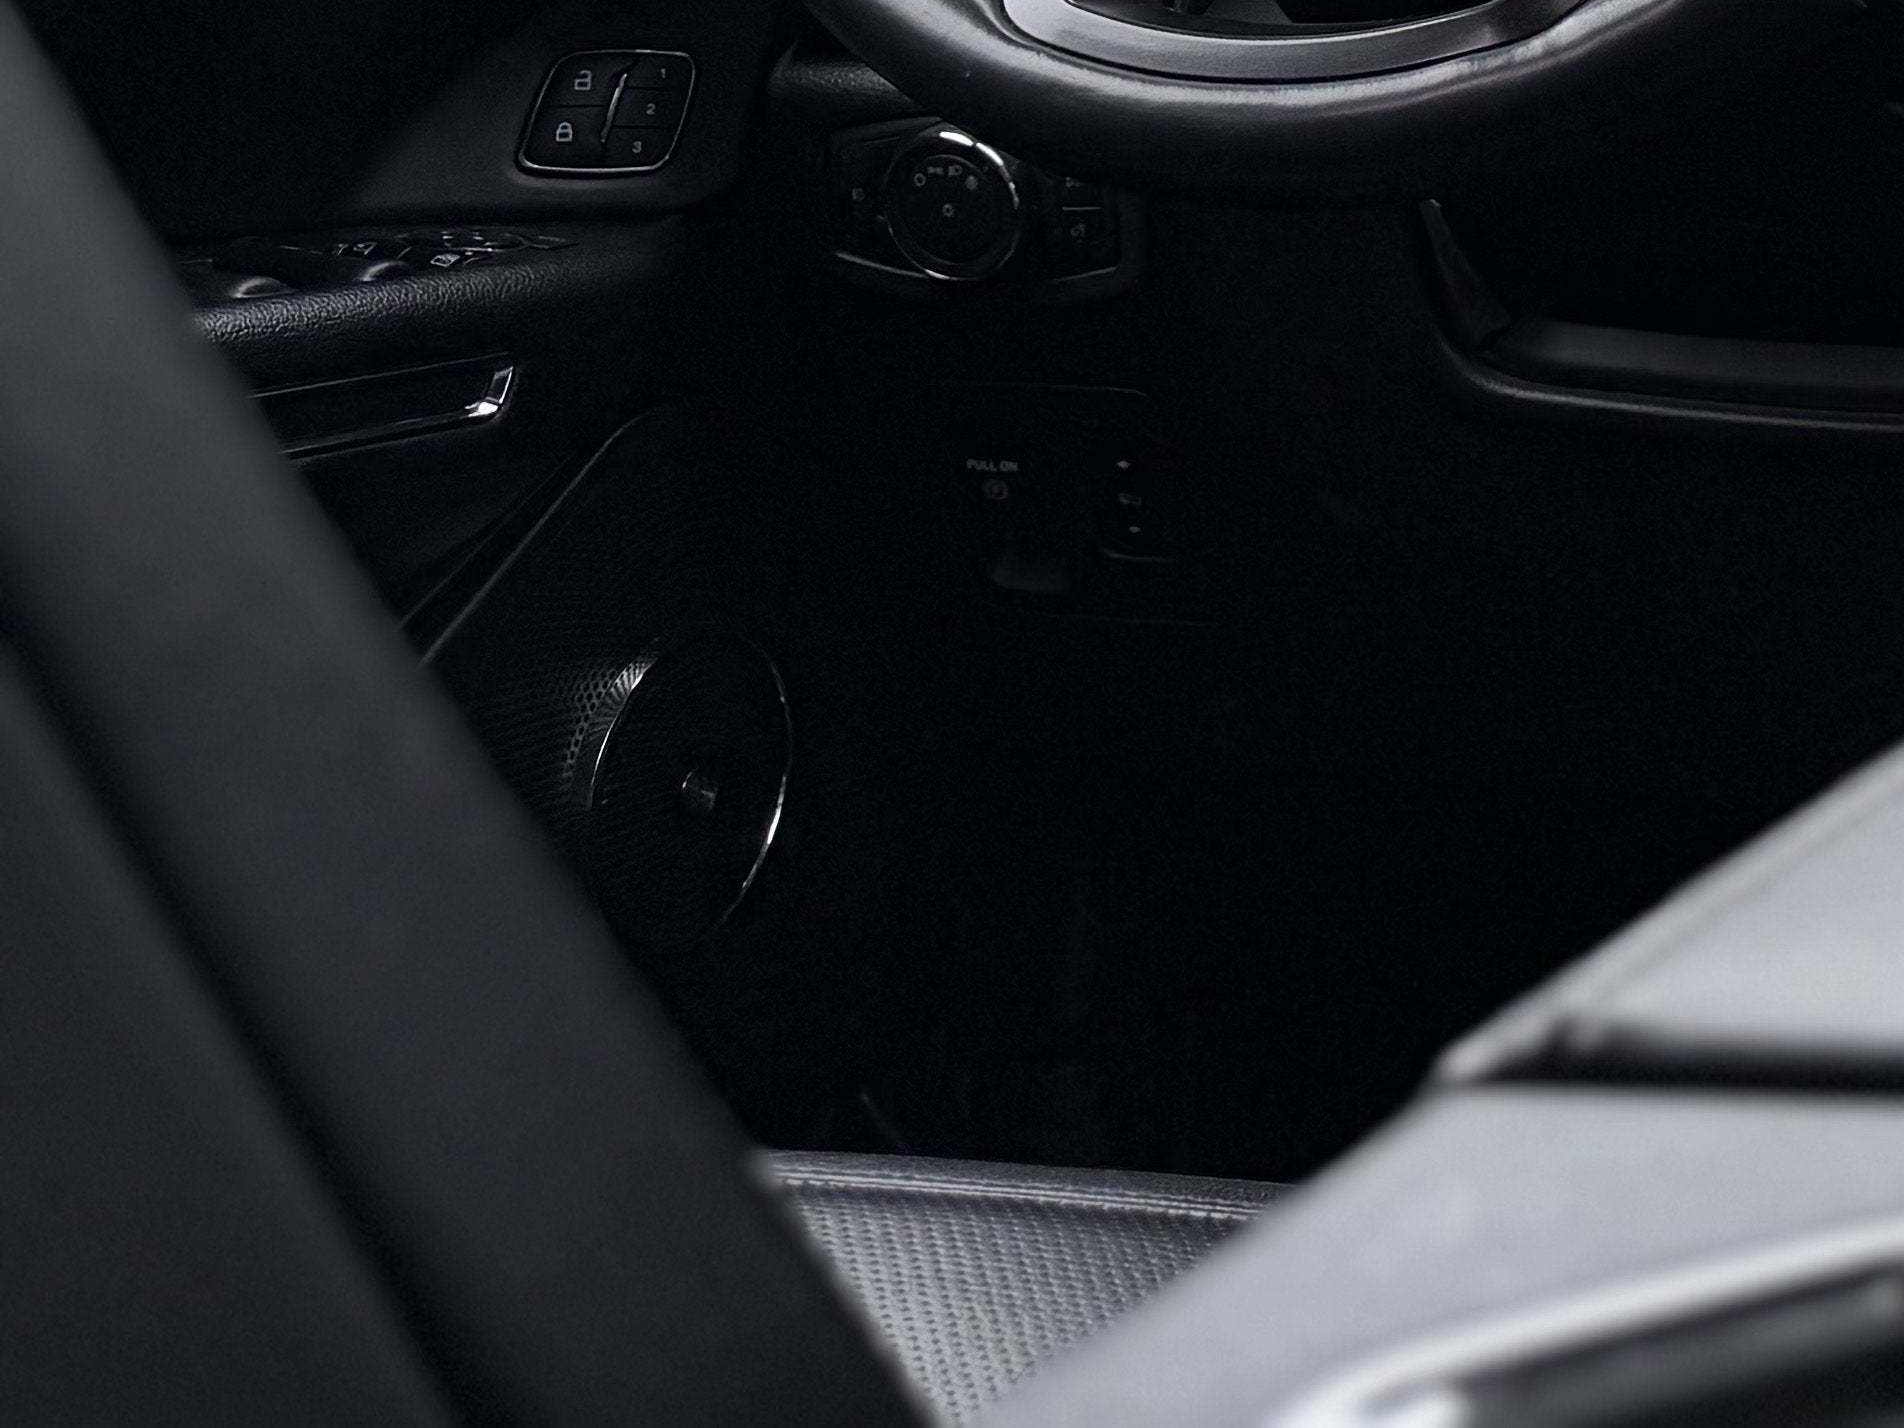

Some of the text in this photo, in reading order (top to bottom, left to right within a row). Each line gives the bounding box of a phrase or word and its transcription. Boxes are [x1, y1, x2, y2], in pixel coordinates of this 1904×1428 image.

[660, 68, 667, 79] 1
[645, 103, 656, 115] 2
[631, 140, 643, 154] 3
